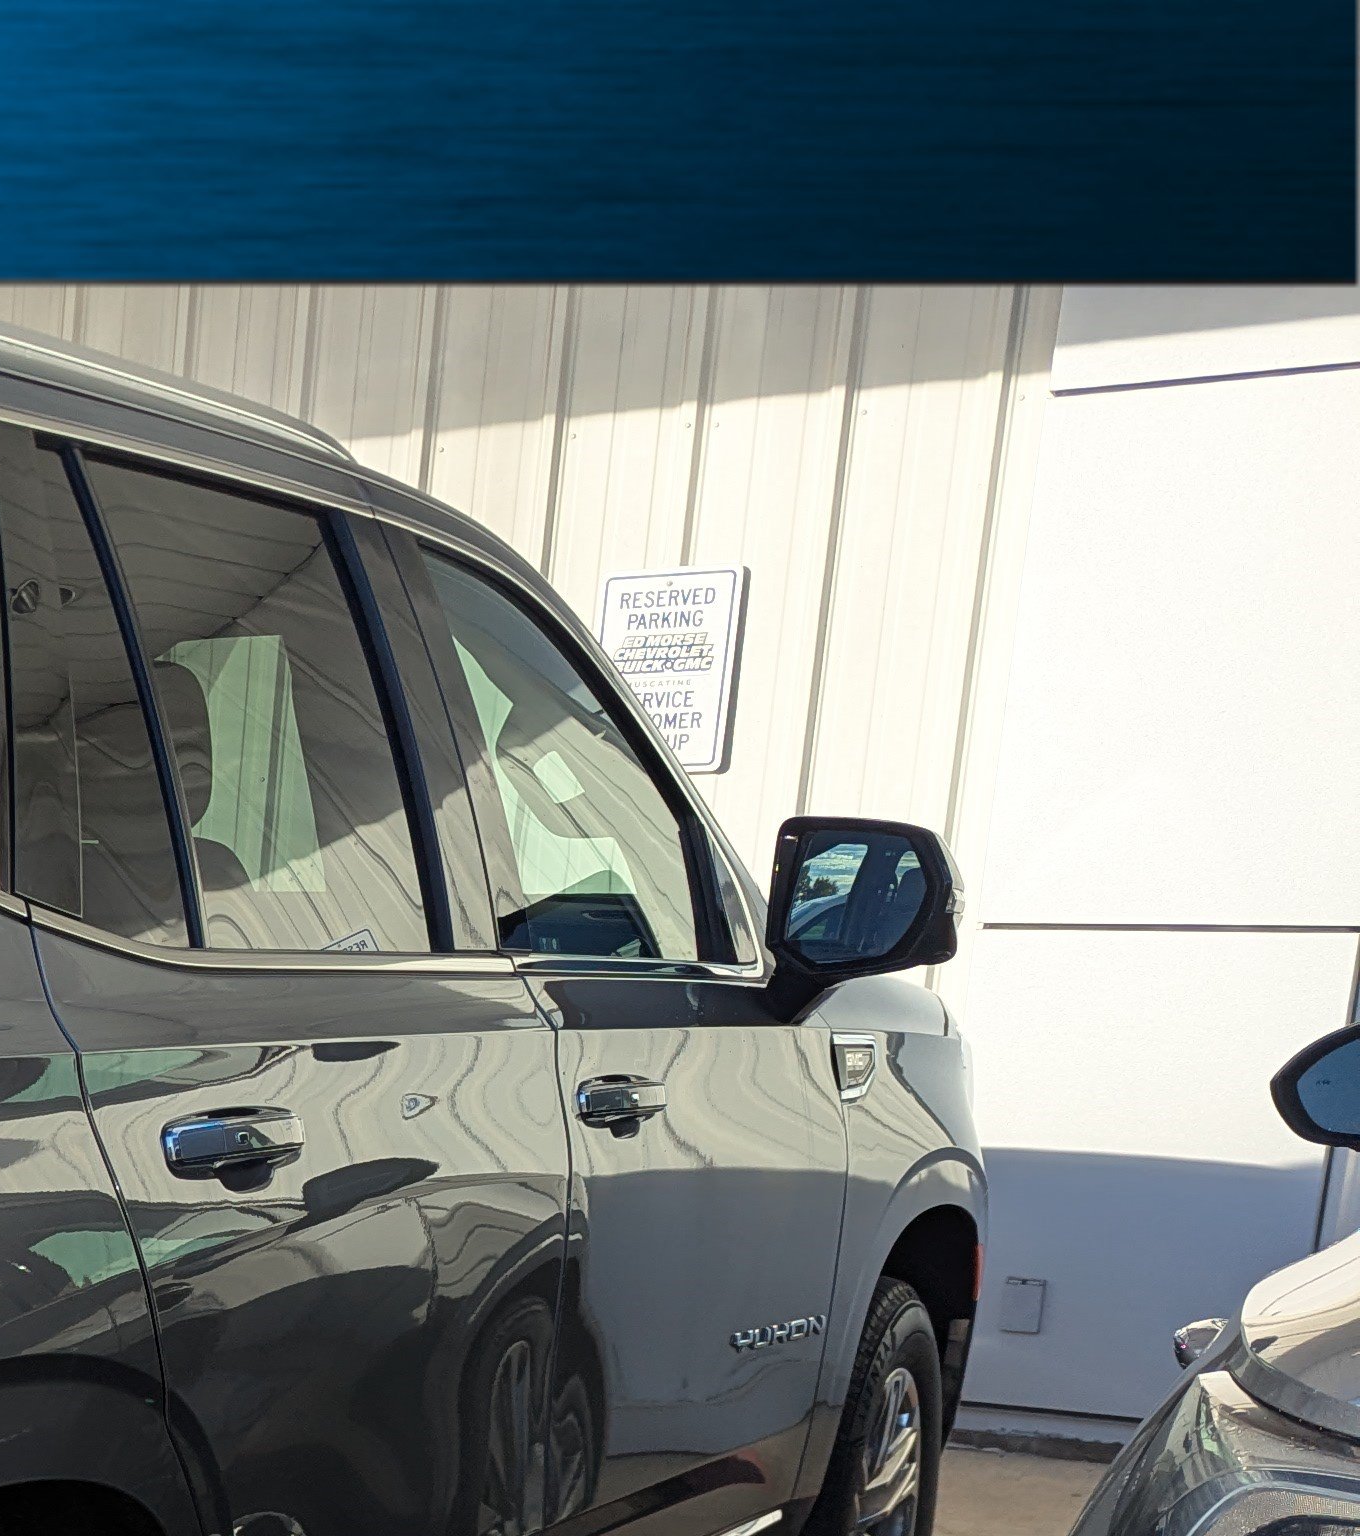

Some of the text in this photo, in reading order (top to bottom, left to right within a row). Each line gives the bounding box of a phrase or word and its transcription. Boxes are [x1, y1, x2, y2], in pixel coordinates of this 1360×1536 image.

[620, 587, 716, 609] RESERVED
[627, 609, 704, 630] PARKING
[622, 632, 708, 649] ED MORSE
[613, 644, 714, 662] CHEVROLET
[672, 656, 714, 672] GMC
[629, 679, 692, 688] USCATINE
[634, 690, 695, 708] RVICE
[729, 1314, 827, 1352] YUKON
